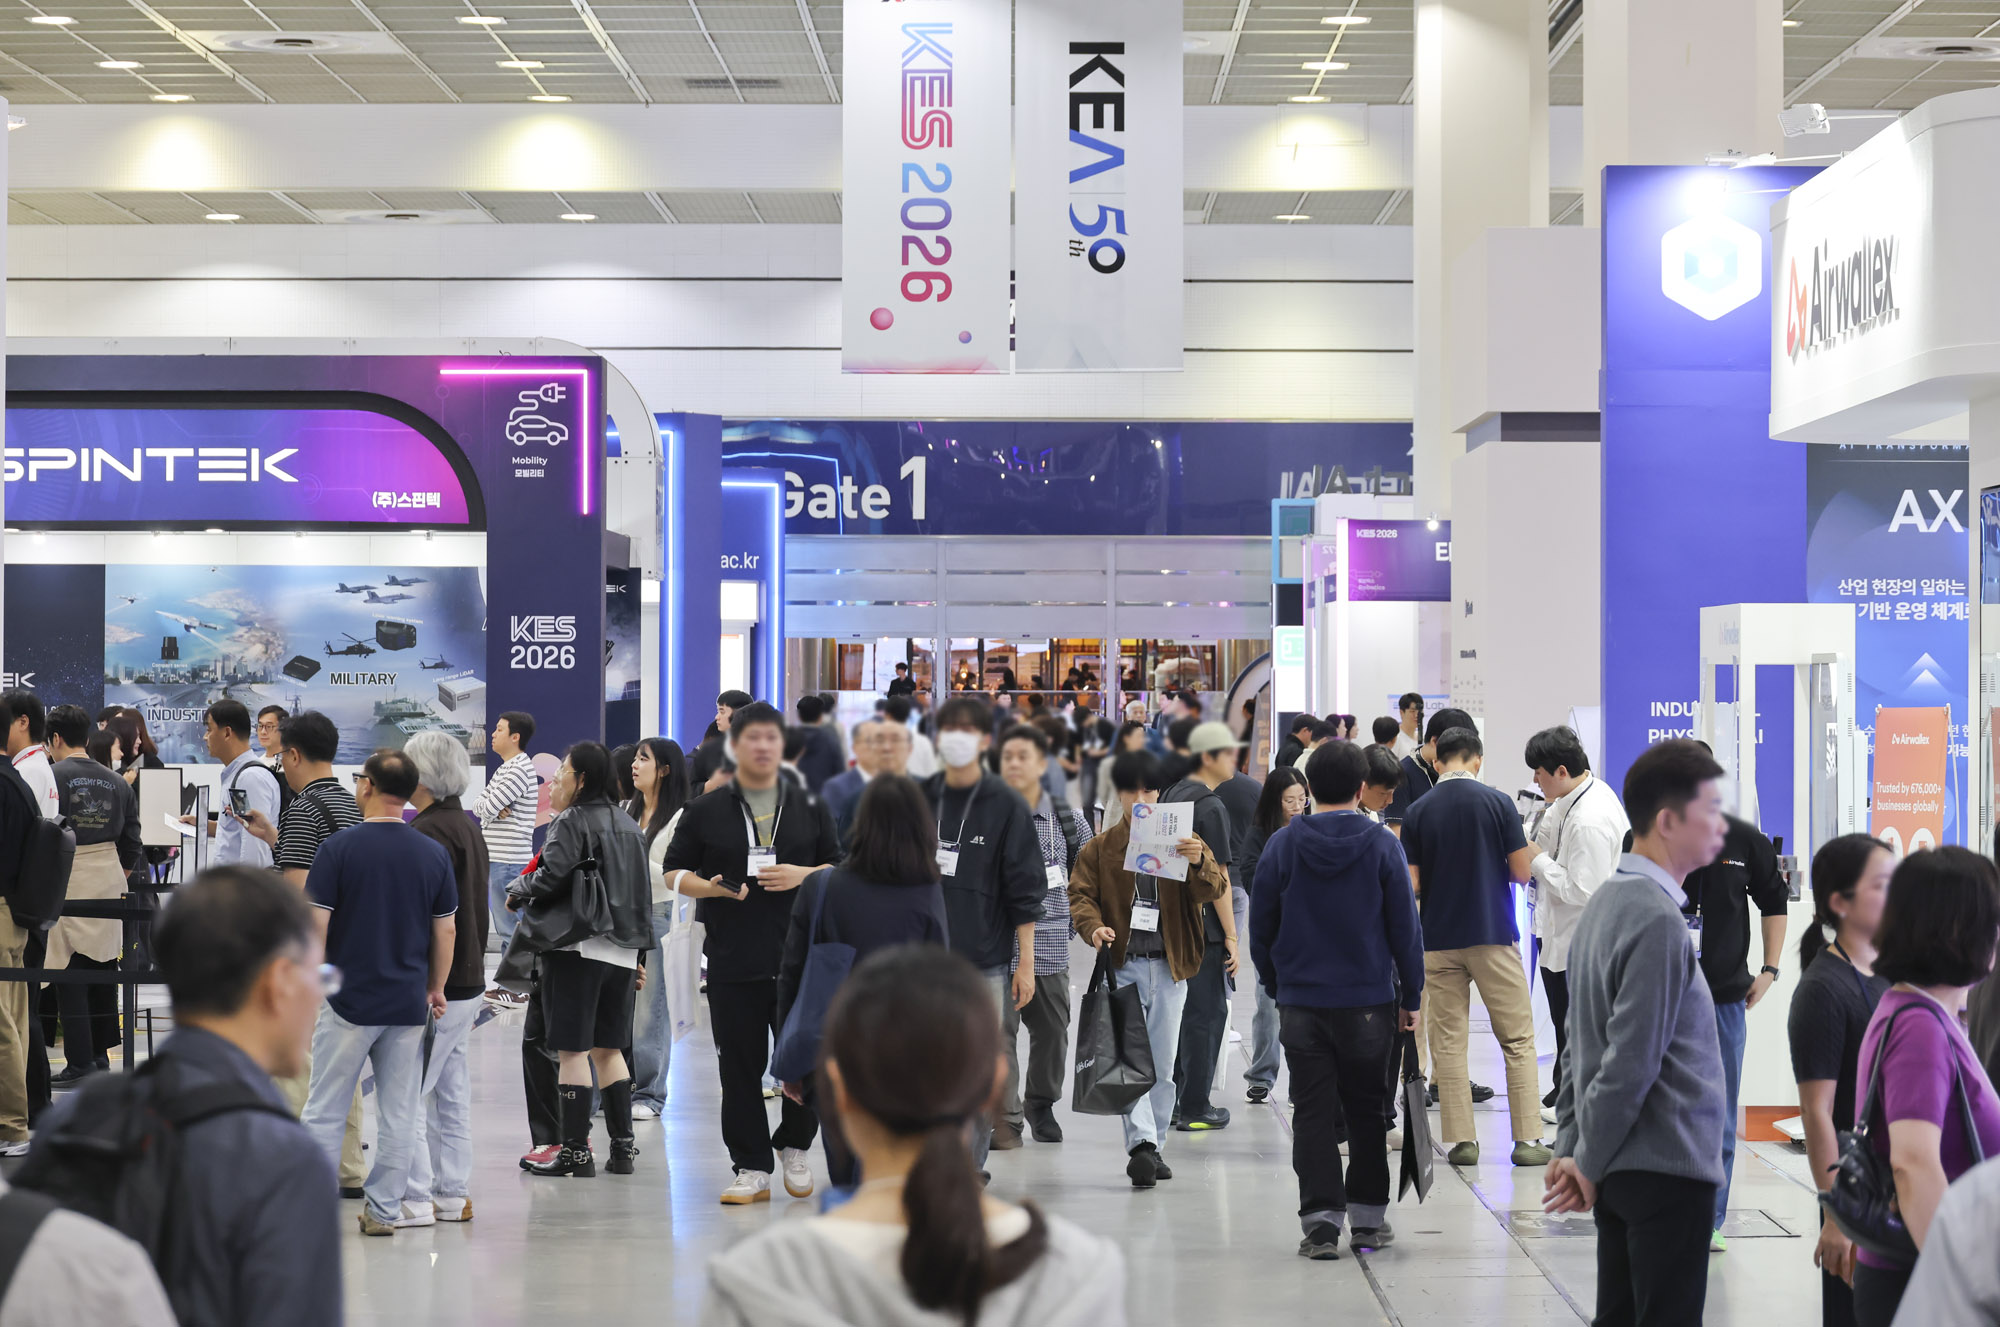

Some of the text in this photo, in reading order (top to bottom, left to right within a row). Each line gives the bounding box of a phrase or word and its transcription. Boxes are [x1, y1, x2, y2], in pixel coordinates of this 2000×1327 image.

[1068, 41, 1125, 185] KEA
[900, 22, 953, 303] KES 2026
[1808, 233, 1896, 347] Airwallex
[512, 456, 548, 466] Mobility
[514, 469, 545, 478] 모빌리티
[900, 456, 927, 520] 1
[372, 491, 441, 509] (주)스핀텍
[1887, 489, 1965, 533] AX
[1376, 529, 1398, 538] 2026
[1837, 578, 1966, 596] 산업 현장의 일하는
[1858, 601, 1891, 621] 기반
[1894, 601, 1927, 621] 운영
[510, 615, 577, 669] KES 2026
[329, 671, 398, 686] MILITARY
[1900, 733, 1930, 745] Airwallex
[1875, 781, 1942, 796] Trusted by 676,000+
[1877, 799, 1939, 815] businesses globally
